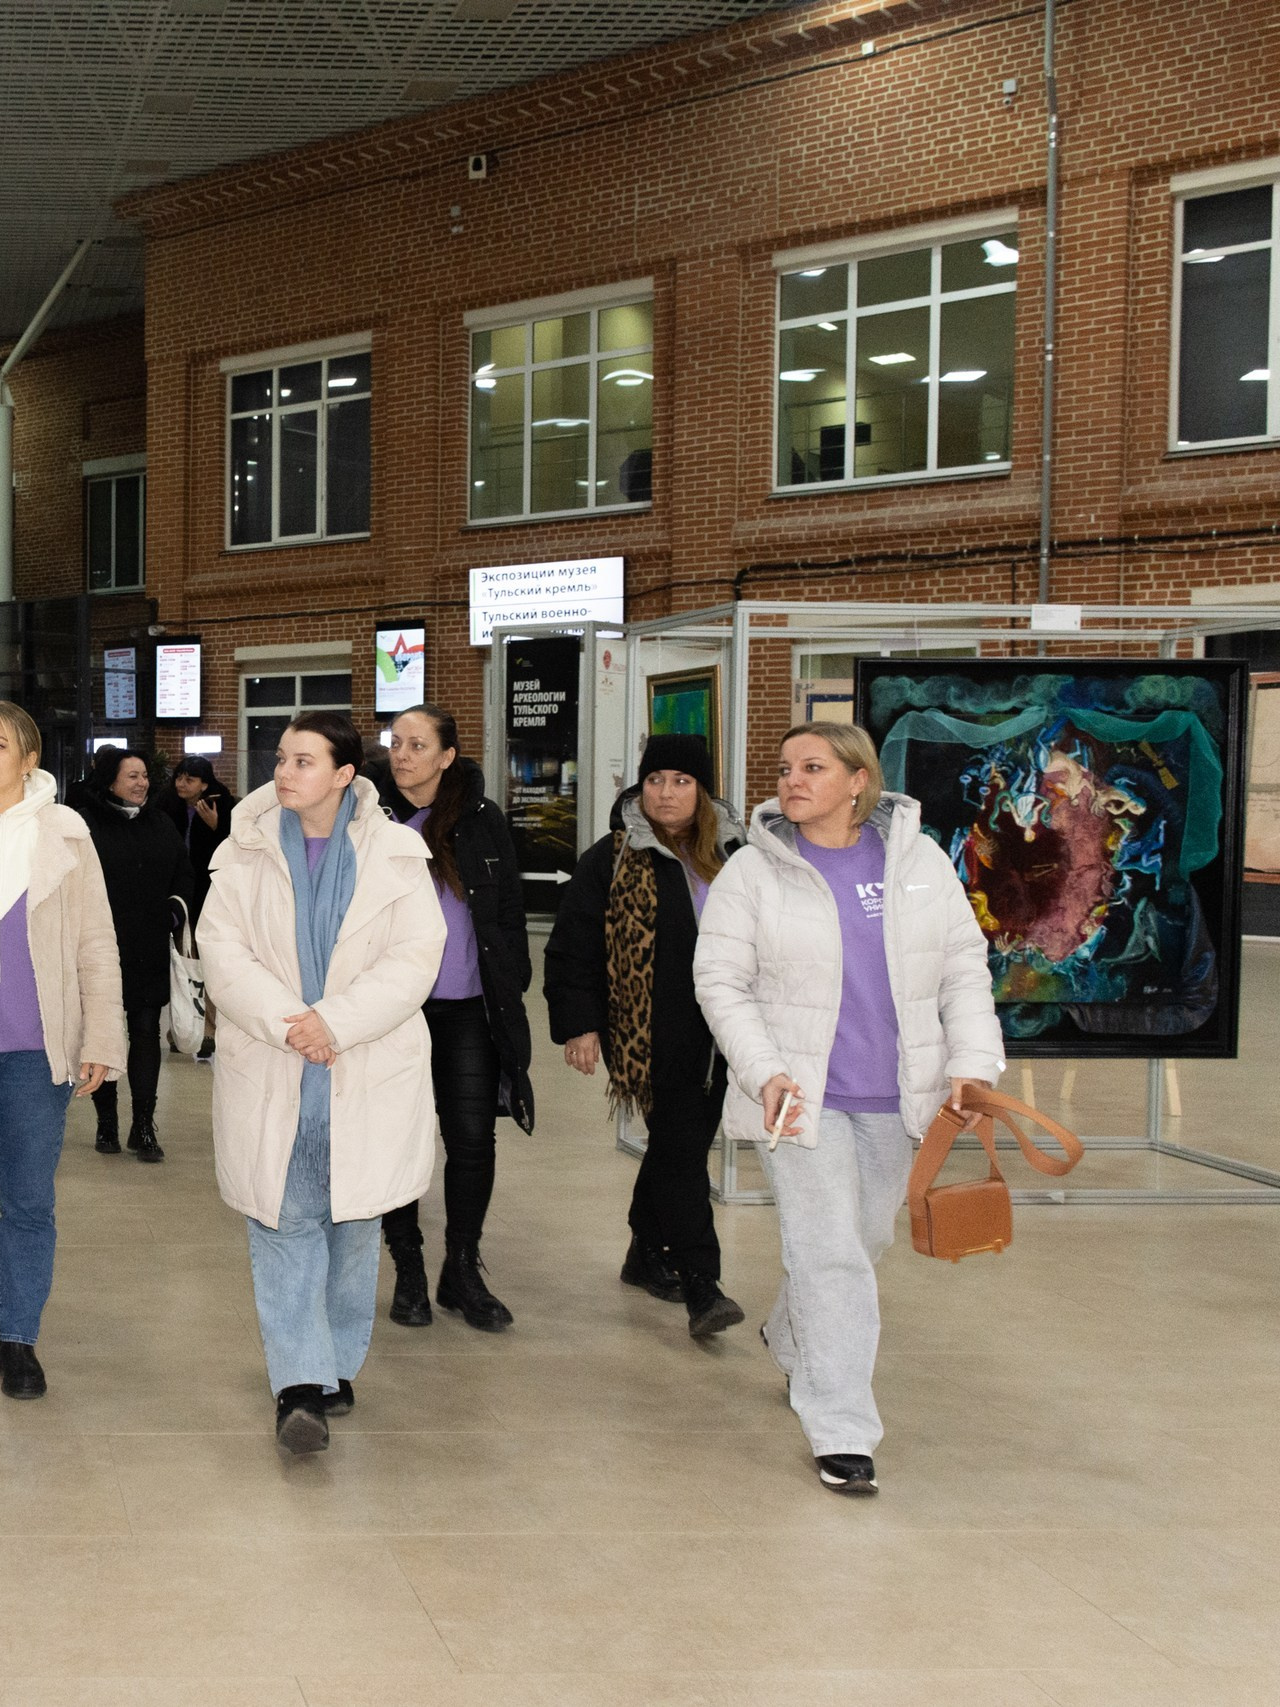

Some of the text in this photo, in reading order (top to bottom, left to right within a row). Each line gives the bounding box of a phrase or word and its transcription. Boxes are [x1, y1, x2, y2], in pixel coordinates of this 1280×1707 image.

[481, 566, 597, 583] Экспозиции музея
[482, 607, 592, 624] Тульский военно-
[513, 678, 540, 691] МУЗЕЙ
[513, 691, 566, 703] АРХЕОЛОГИИ
[513, 704, 559, 715] ТУЛЬСКОГО
[513, 716, 546, 727] КРЕМЛЯ
